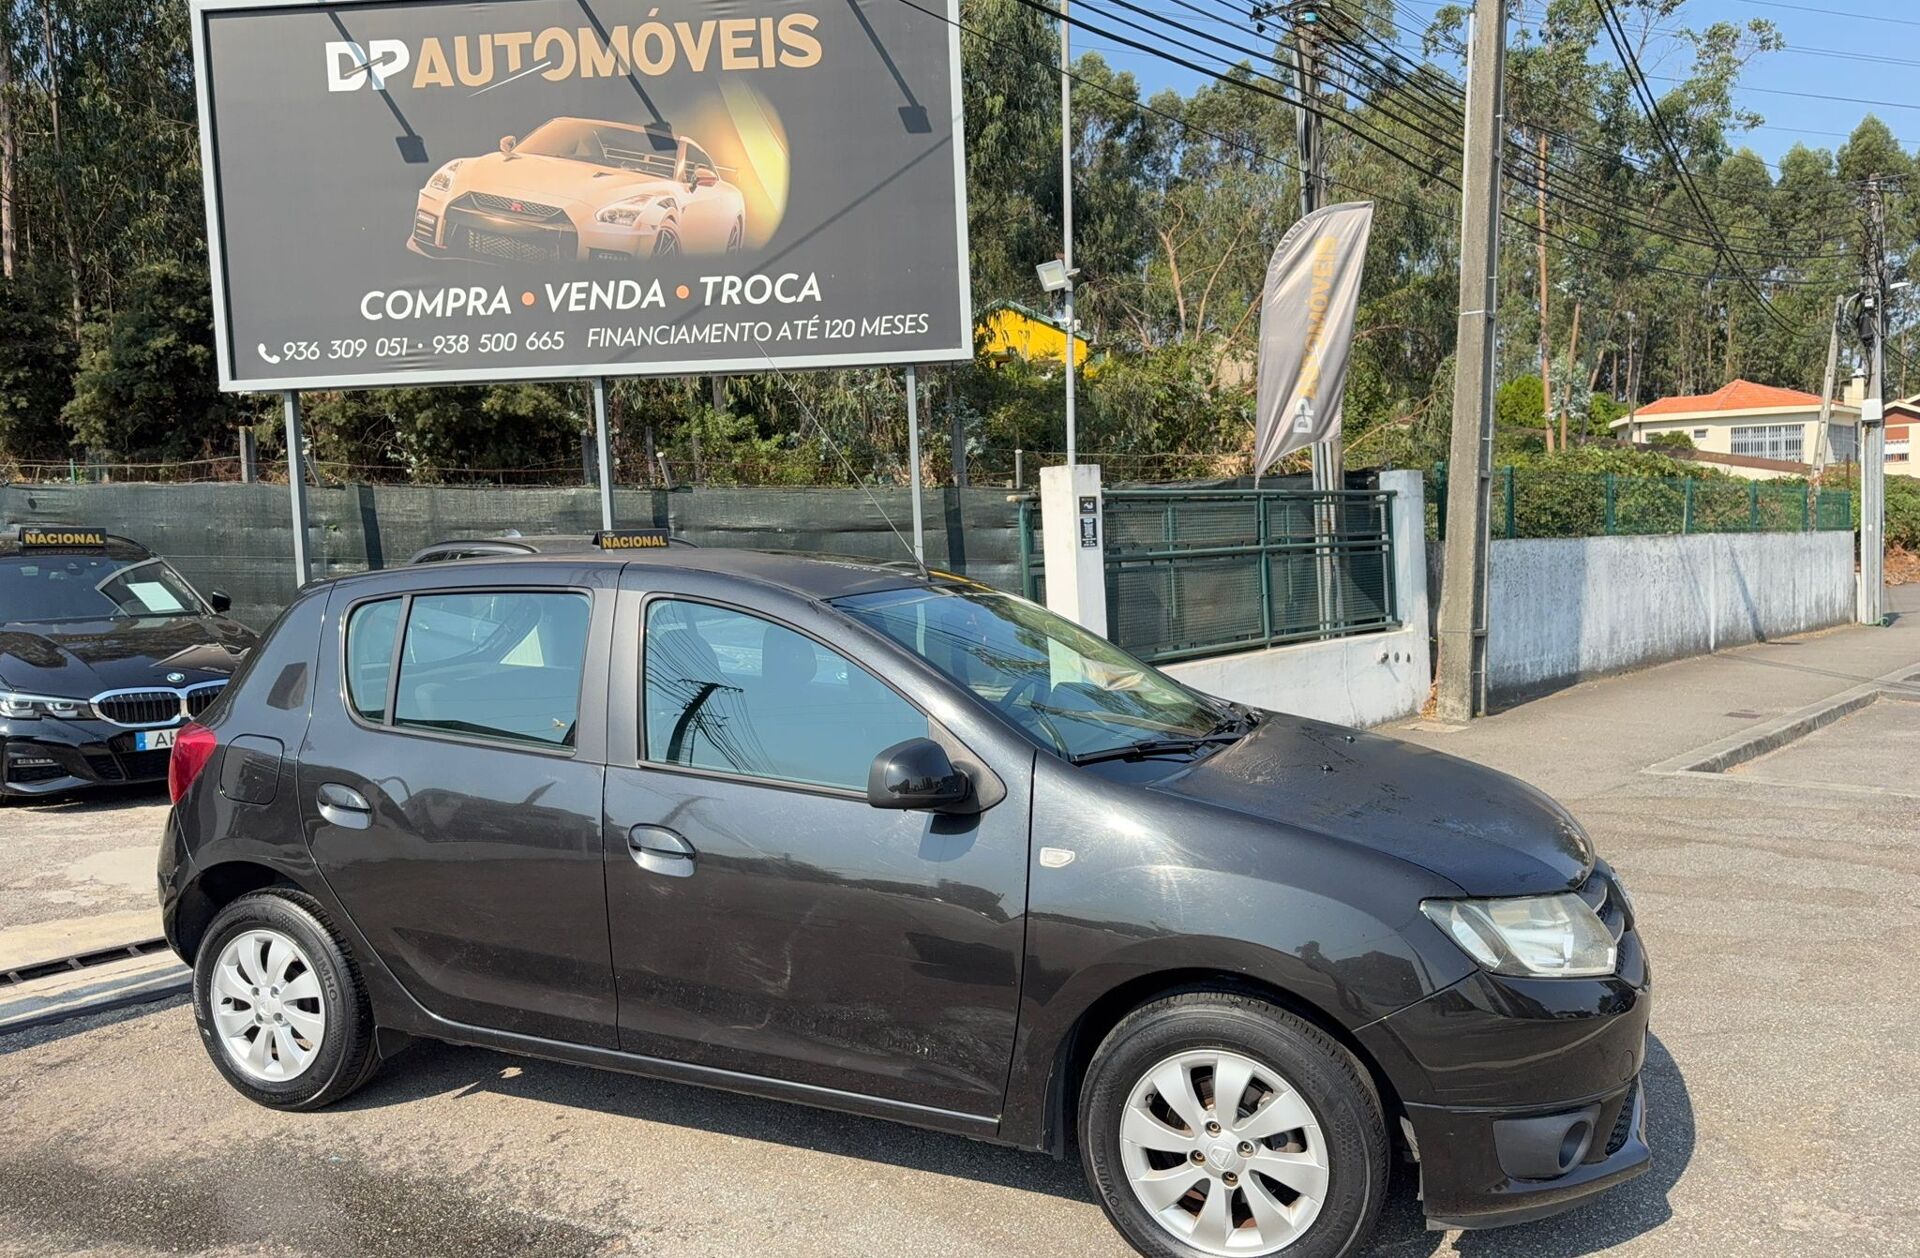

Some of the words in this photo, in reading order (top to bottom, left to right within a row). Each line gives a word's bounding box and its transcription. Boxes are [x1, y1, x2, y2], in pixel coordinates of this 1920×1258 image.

[360, 285, 512, 321] COMPRA
[545, 278, 666, 312] VENDA
[699, 271, 822, 306] TROCA
[283, 341, 320, 361] 936
[327, 339, 368, 359] 309
[375, 337, 408, 357] 051
[432, 335, 470, 354] 938
[477, 332, 518, 353] 500
[525, 330, 565, 351] 665
[587, 321, 772, 348] FINANCIAMENTO
[776, 314, 819, 341] ATÉ
[824, 318, 856, 339] 120
[860, 312, 929, 337] MESES
[25, 533, 104, 544] NACIONAL
[602, 535, 667, 548] NACIONAL
